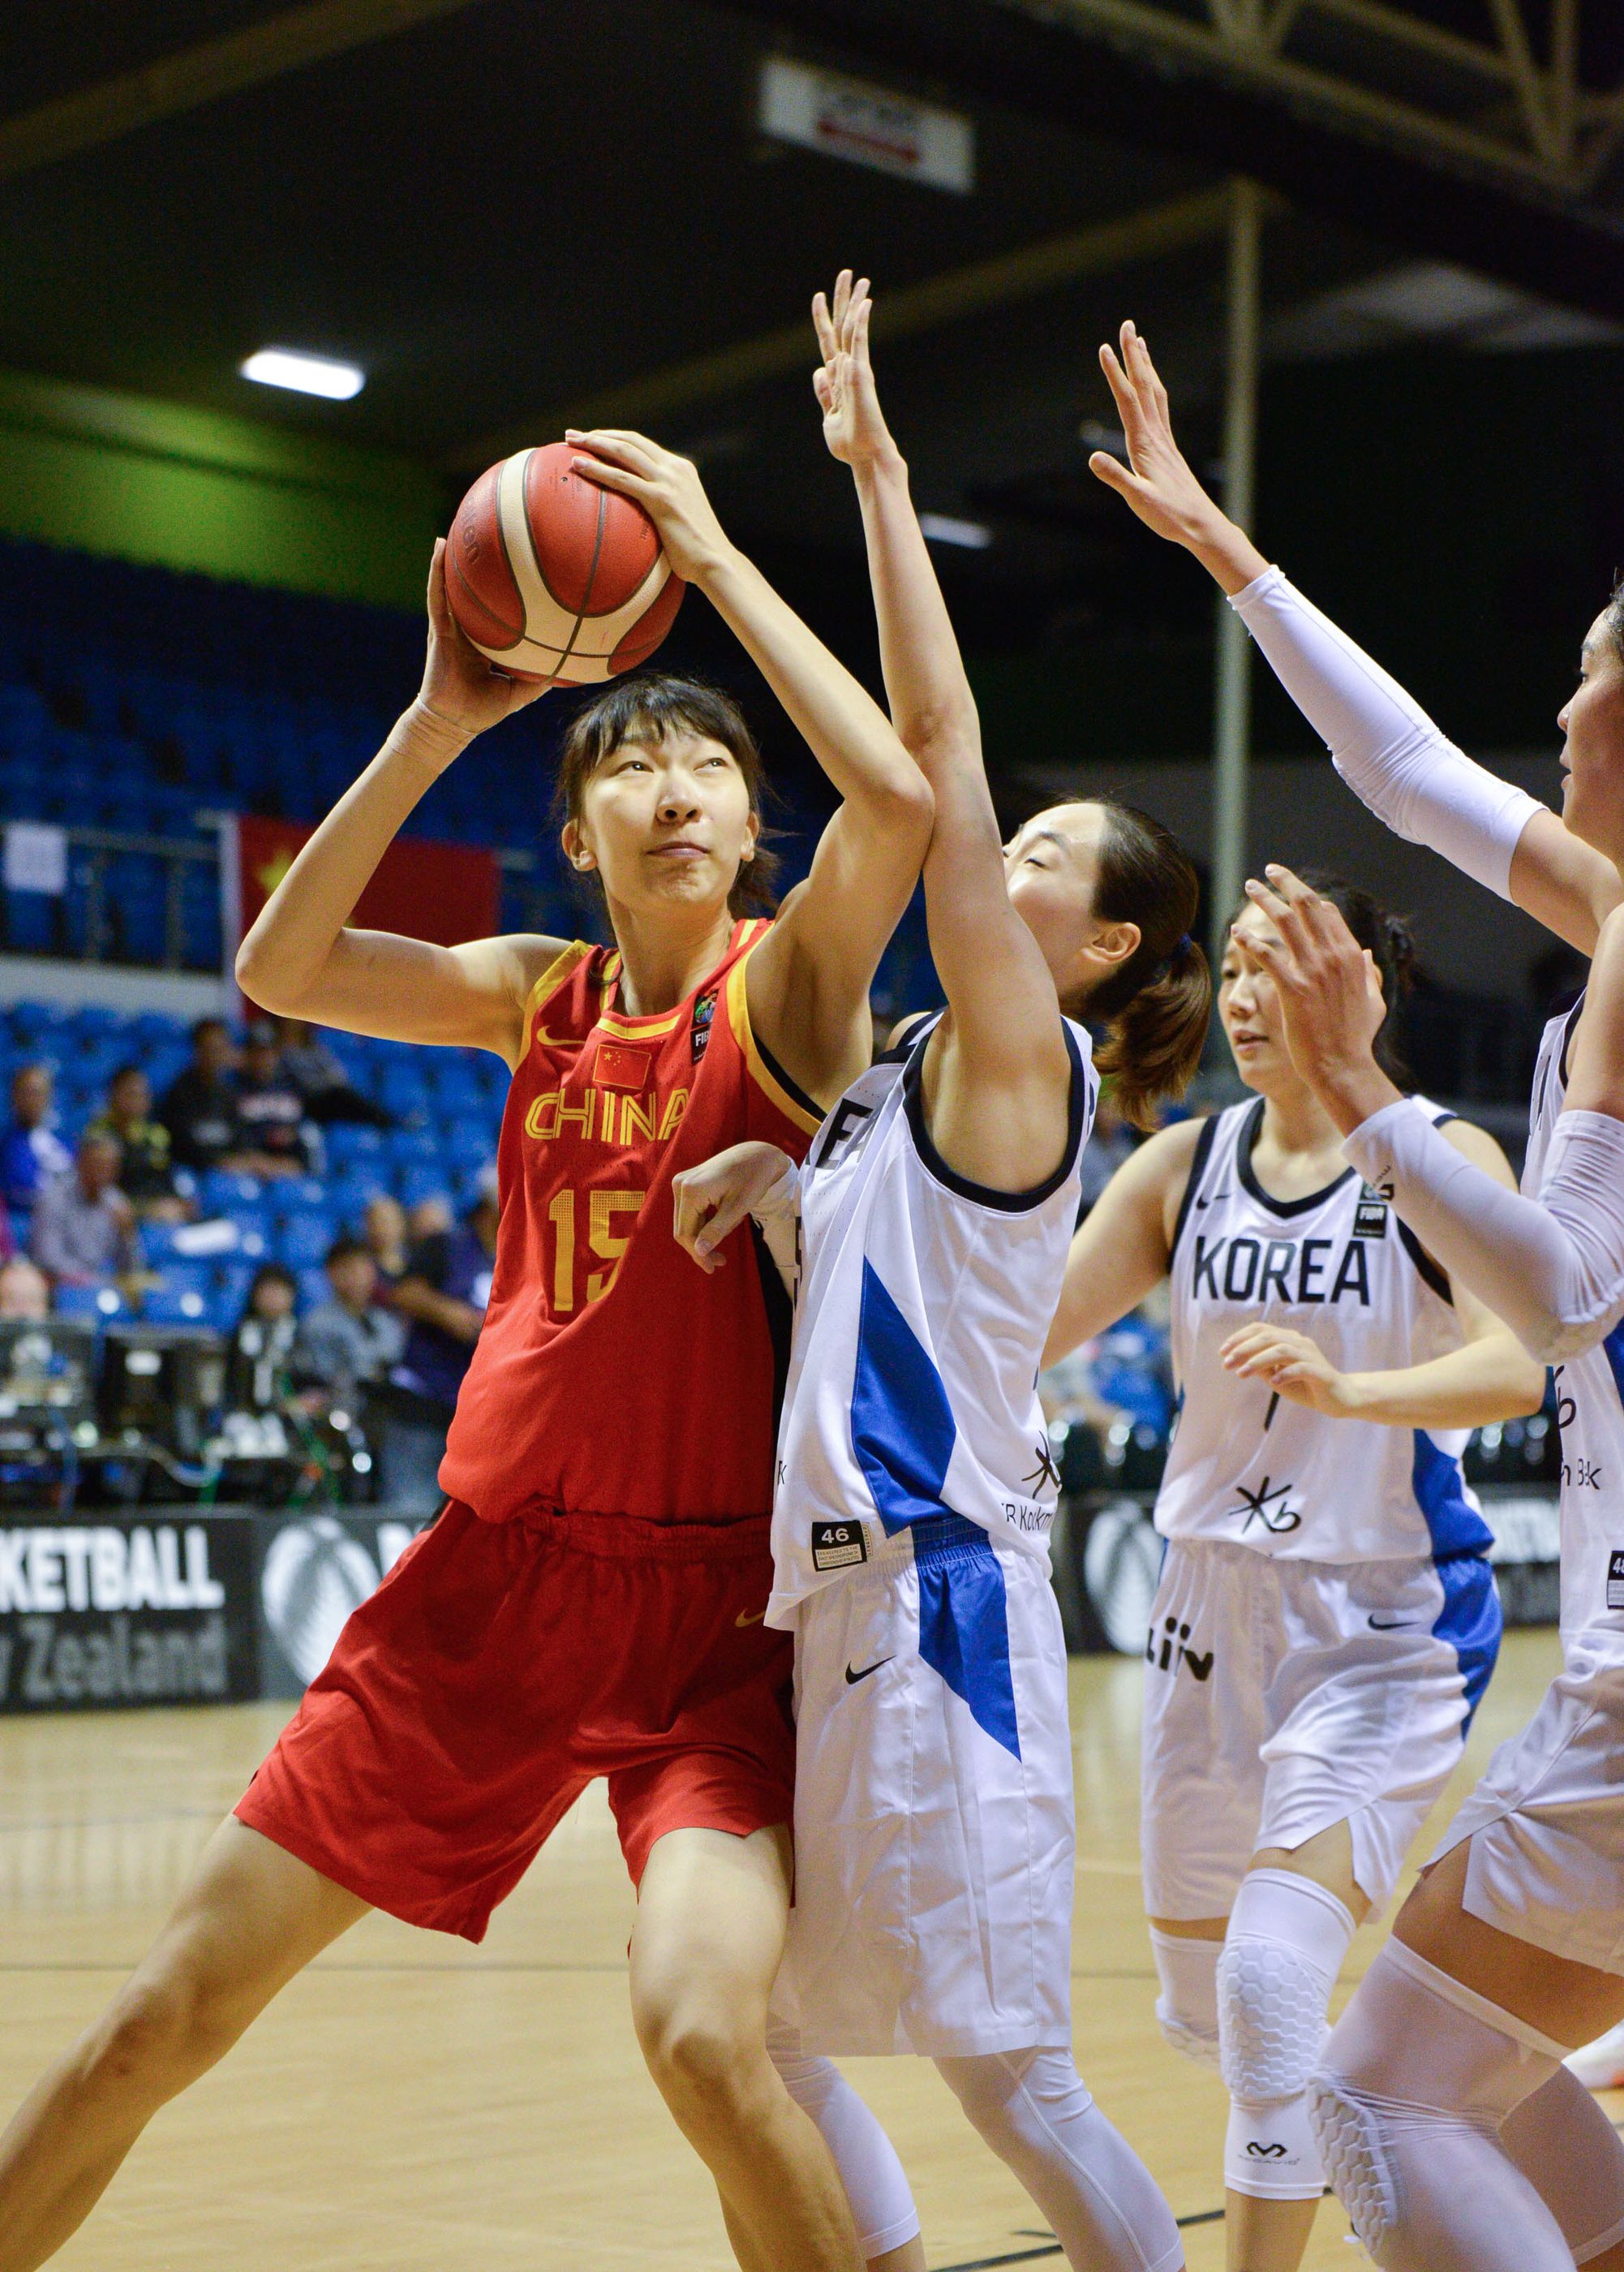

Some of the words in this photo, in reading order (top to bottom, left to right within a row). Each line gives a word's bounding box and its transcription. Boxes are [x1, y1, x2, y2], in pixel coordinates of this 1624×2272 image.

[526, 1088, 690, 1146] CHINA
[549, 1190, 646, 1311] 15
[1192, 1236, 1370, 1306] KOREA
[0, 1525, 225, 1612] KETBALL
[821, 1528, 849, 1543] 46
